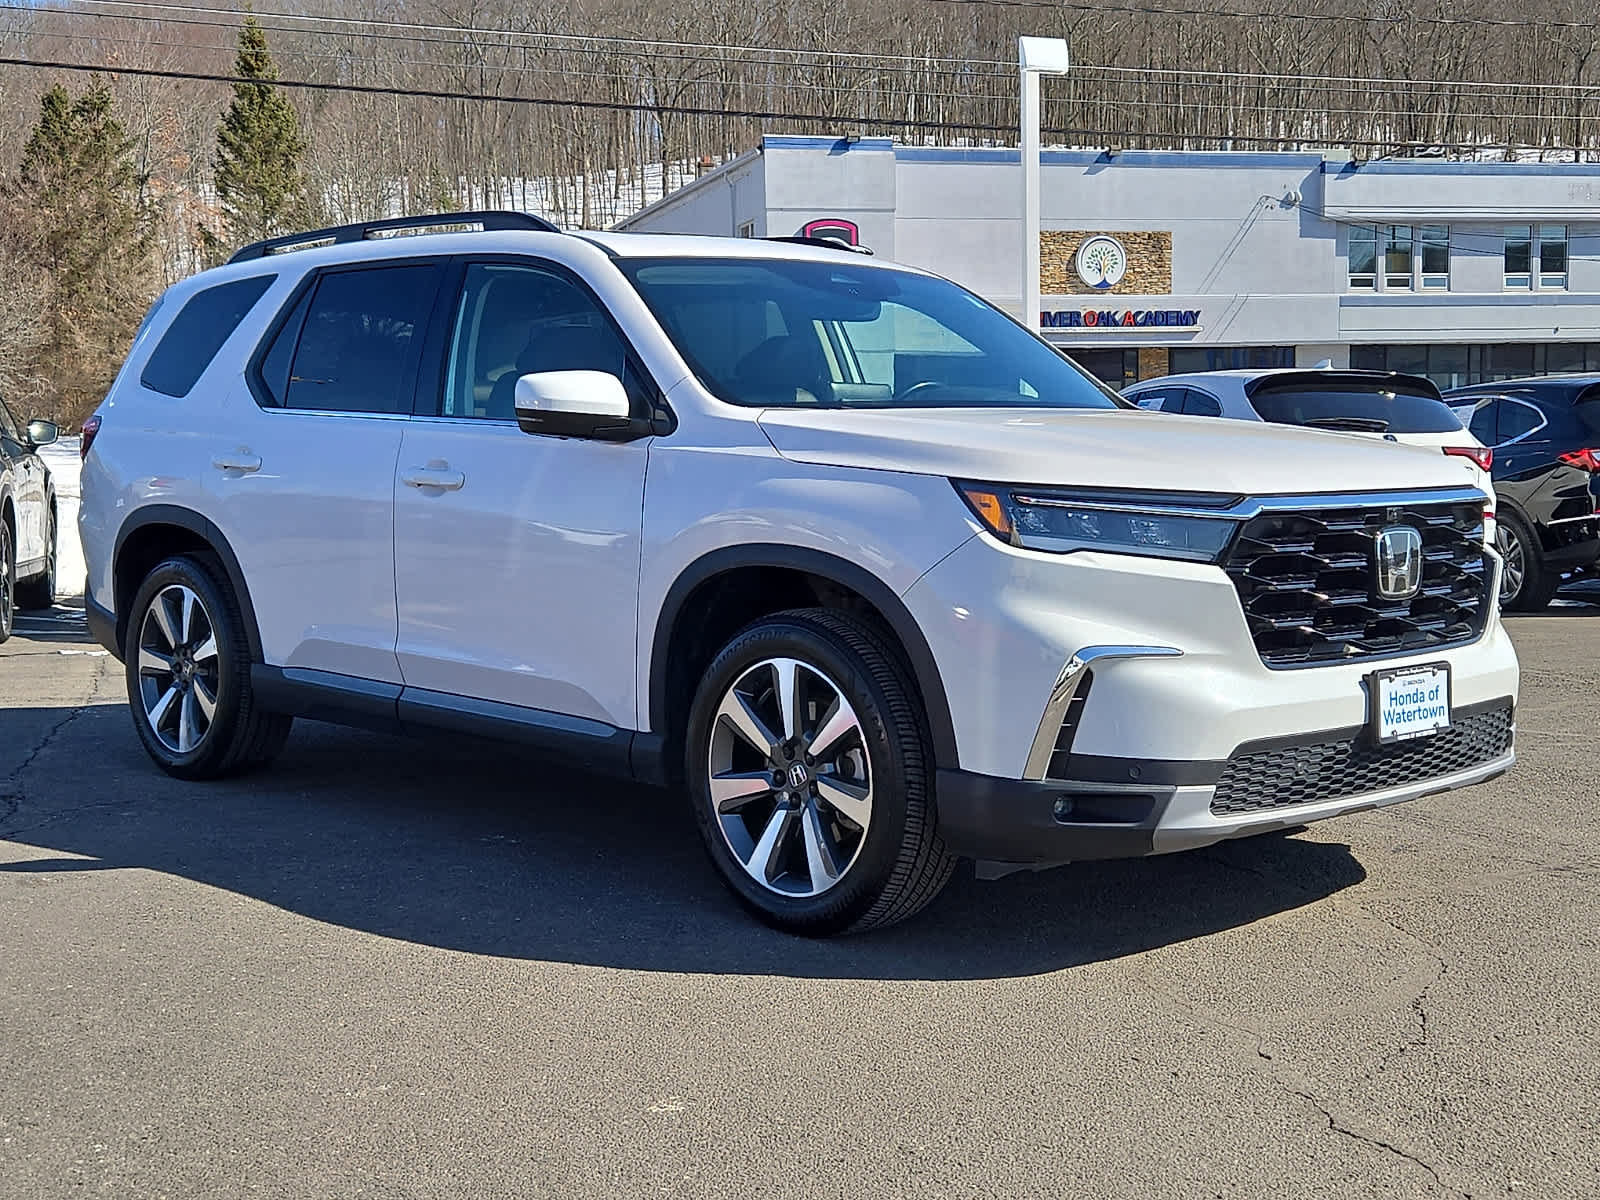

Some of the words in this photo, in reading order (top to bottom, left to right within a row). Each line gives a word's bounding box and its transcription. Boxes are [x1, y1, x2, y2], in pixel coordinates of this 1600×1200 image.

[1040, 311, 1081, 327] IVER
[1083, 310, 1120, 327] OAK
[1122, 310, 1201, 327] ACADEMY
[1389, 688, 1425, 707] Honda
[1428, 684, 1440, 701] of
[1383, 705, 1445, 726] Watertown
